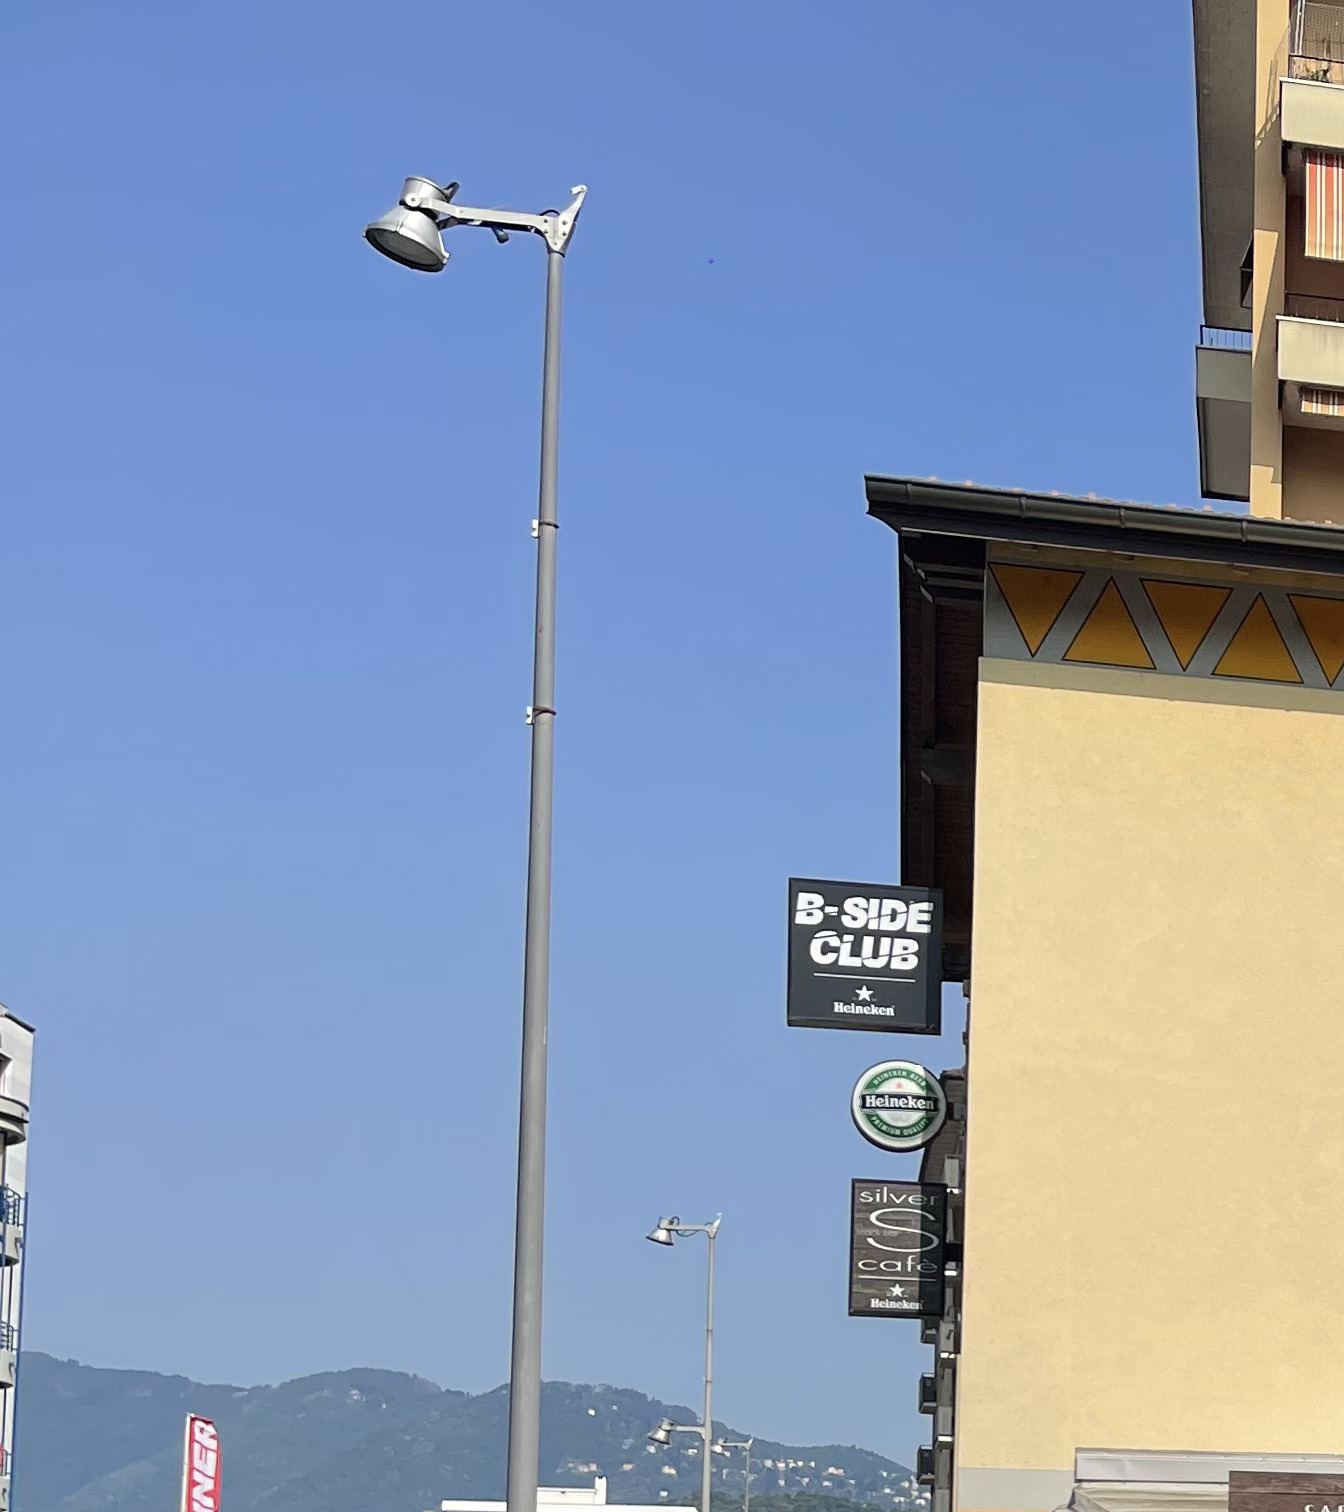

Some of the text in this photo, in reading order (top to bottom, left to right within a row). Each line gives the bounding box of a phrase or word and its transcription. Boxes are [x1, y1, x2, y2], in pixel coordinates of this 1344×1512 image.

[794, 891, 934, 934] B-SIDE
[810, 930, 920, 971] CLUB
[833, 1001, 896, 1017] Heineken
[865, 1095, 935, 1110] Heineken
[859, 1186, 940, 1206] silver
[866, 1207, 940, 1253] S
[870, 1298, 924, 1310] Heineken
